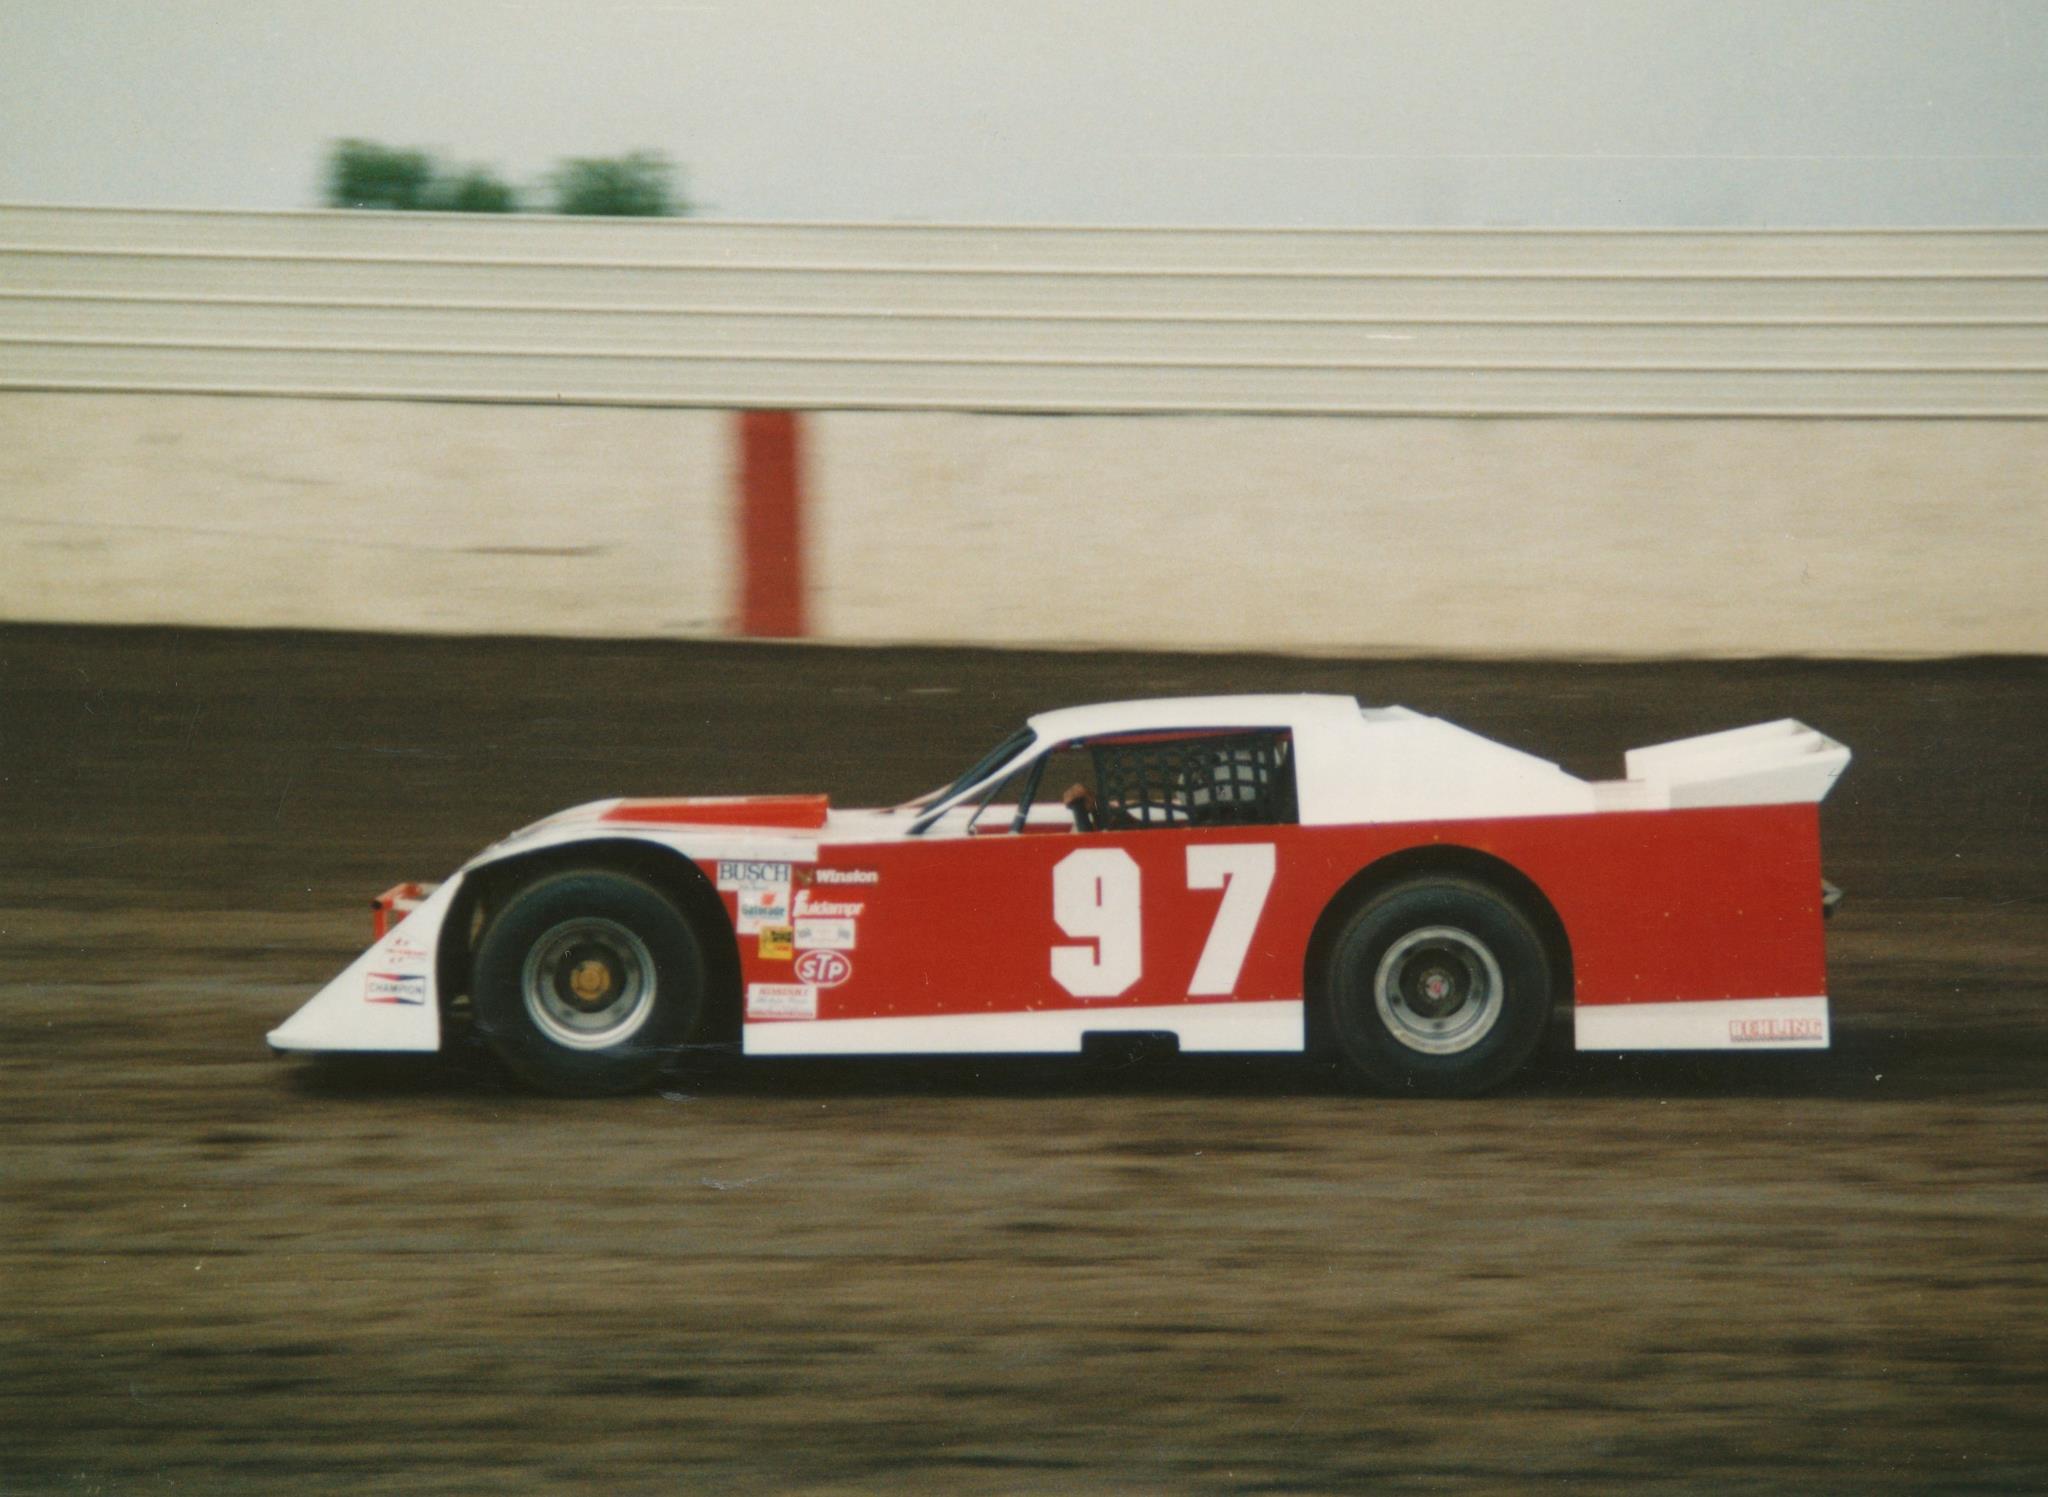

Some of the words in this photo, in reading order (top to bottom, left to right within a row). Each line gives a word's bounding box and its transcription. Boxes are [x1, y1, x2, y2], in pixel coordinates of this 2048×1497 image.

[719, 863, 788, 882] BUSCH
[816, 869, 879, 884] Winston
[1051, 843, 1276, 997] 97
[802, 954, 844, 981] STP
[369, 982, 423, 994] CHAMPION
